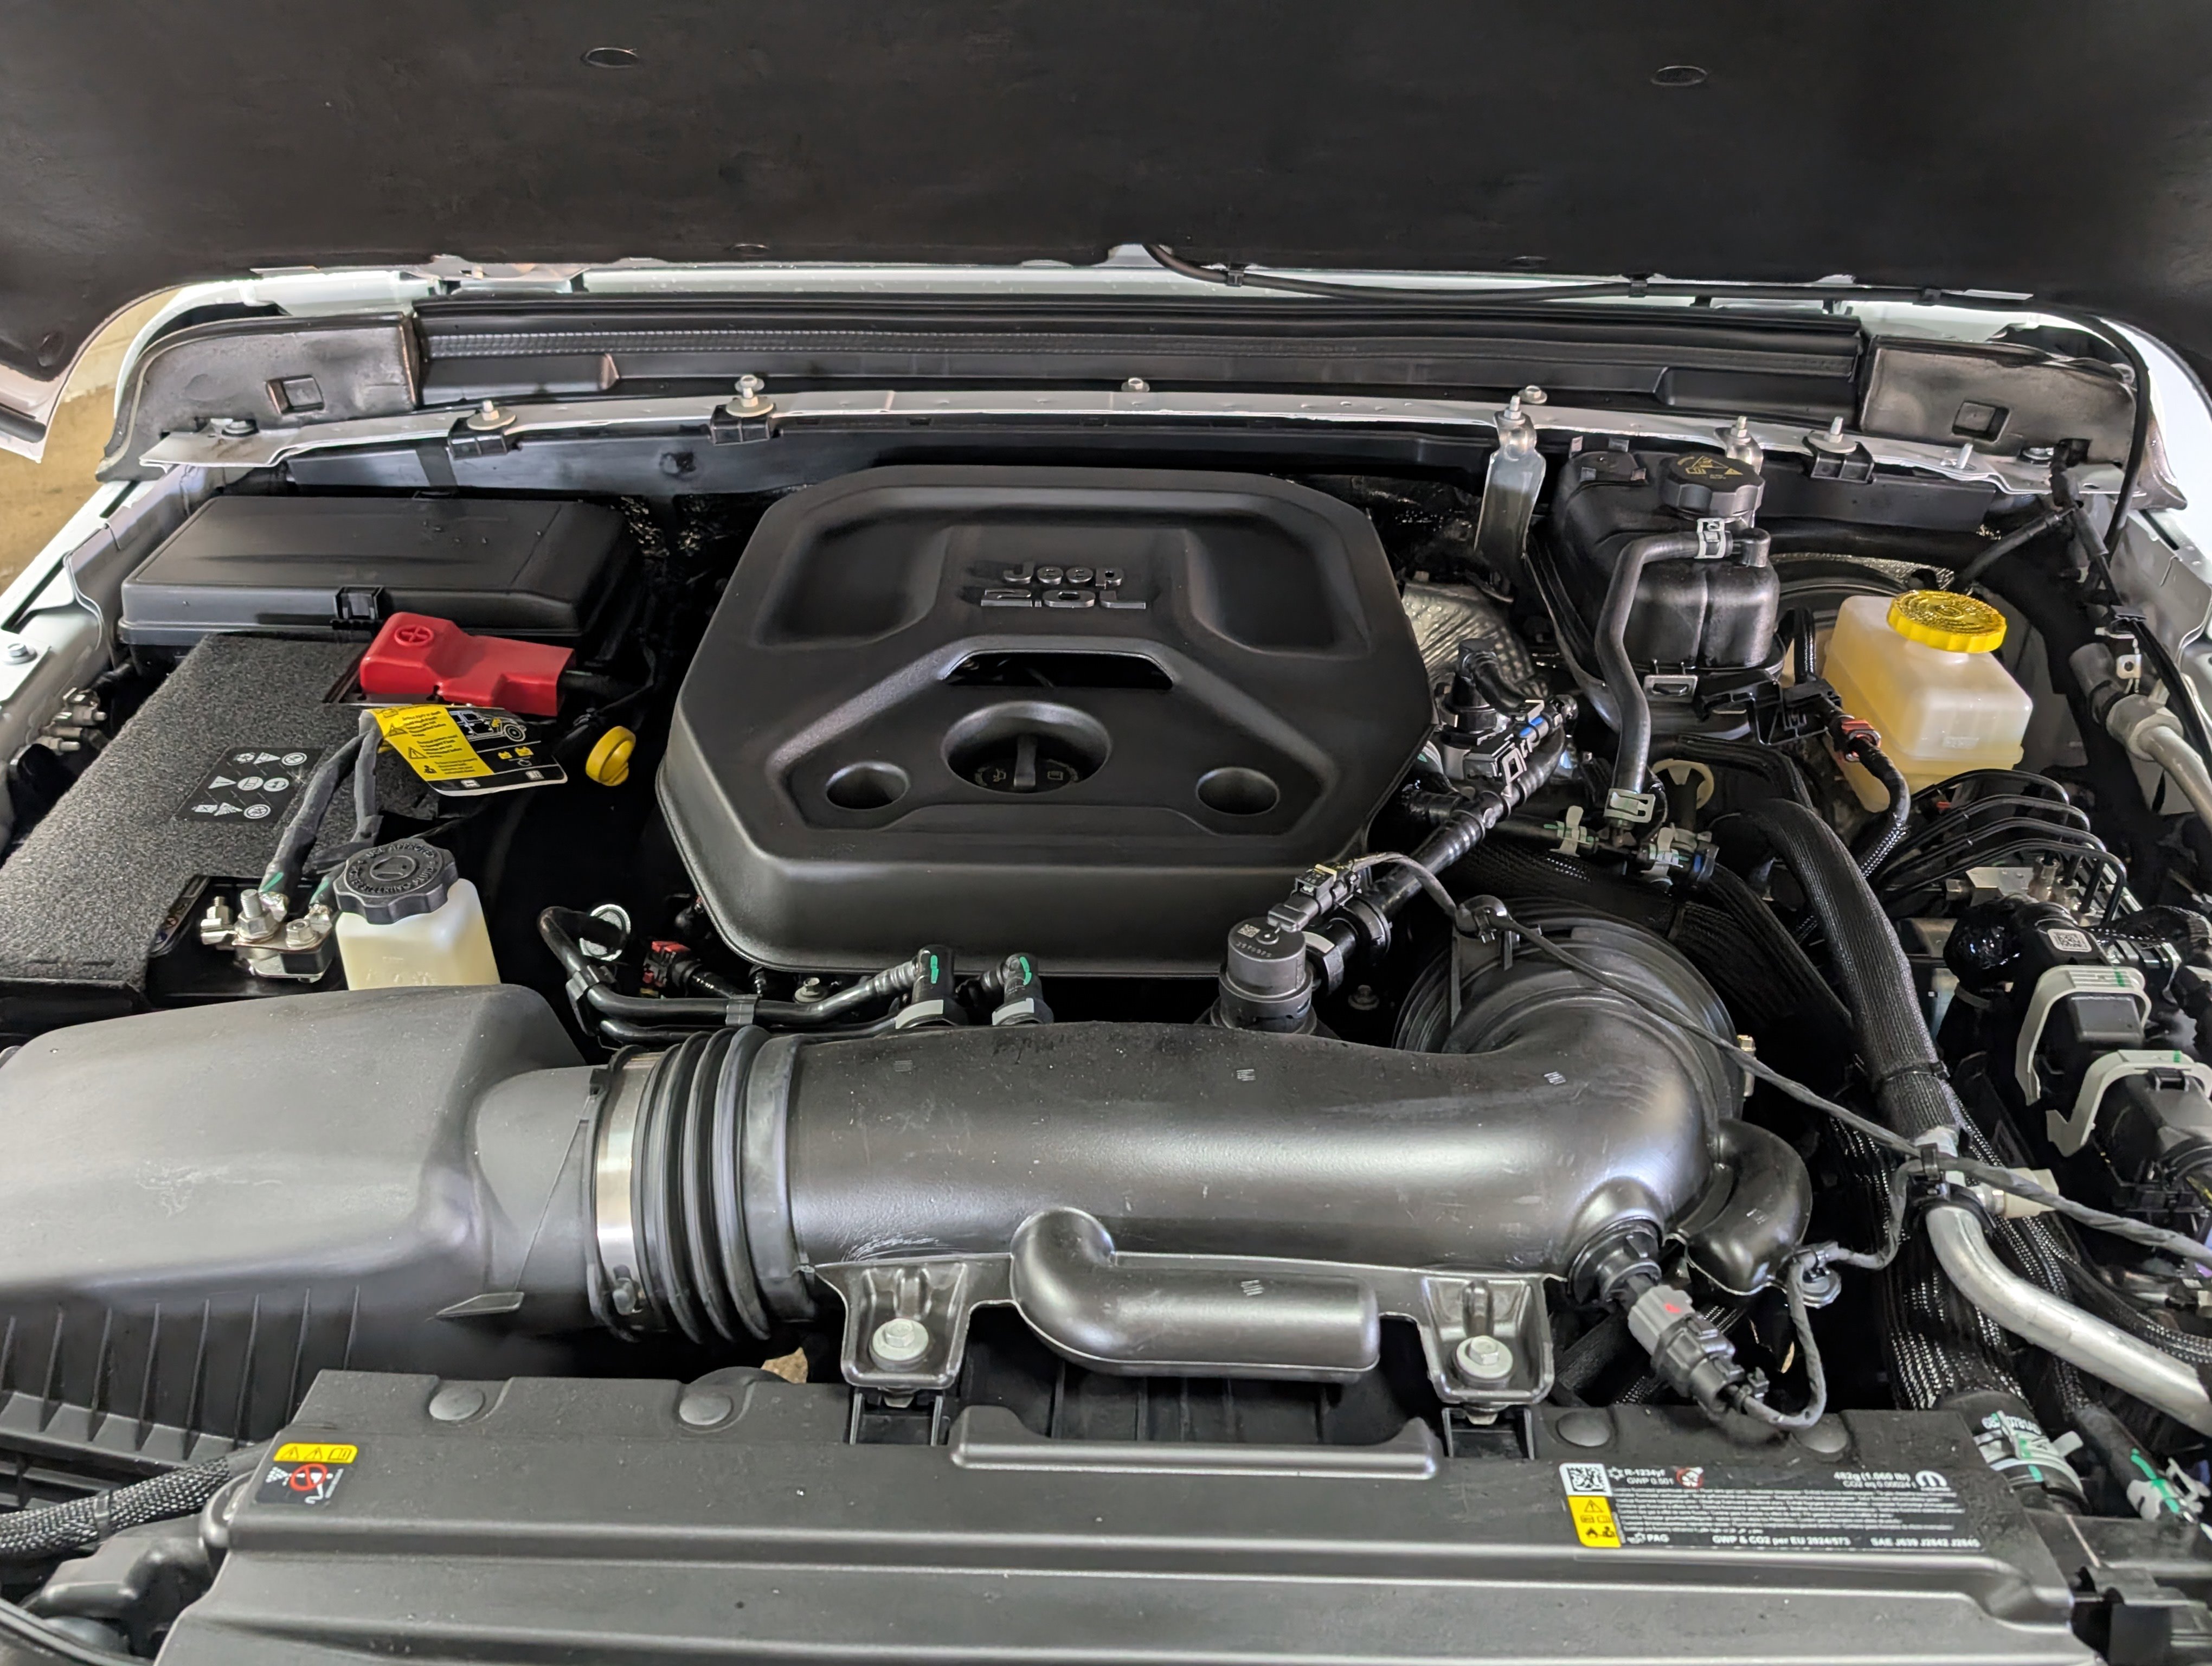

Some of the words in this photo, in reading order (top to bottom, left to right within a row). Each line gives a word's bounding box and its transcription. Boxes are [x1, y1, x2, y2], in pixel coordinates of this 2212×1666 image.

[1003, 561, 1124, 589] Jeep
[981, 588, 1146, 608] 2.0L
[388, 843, 435, 858] APPROVED
[1624, 1469, 1666, 1478] R-1234yf
[1650, 1477, 1675, 1485] 0.501
[1647, 1535, 1670, 1543] PAG
[1712, 1535, 1735, 1543] GWP
[1739, 1536, 1747, 1544] &
[1748, 1536, 1771, 1544] CO2
[1772, 1537, 1789, 1546] per
[1790, 1536, 1806, 1545] EU
[1870, 1537, 1894, 1547] SAE
